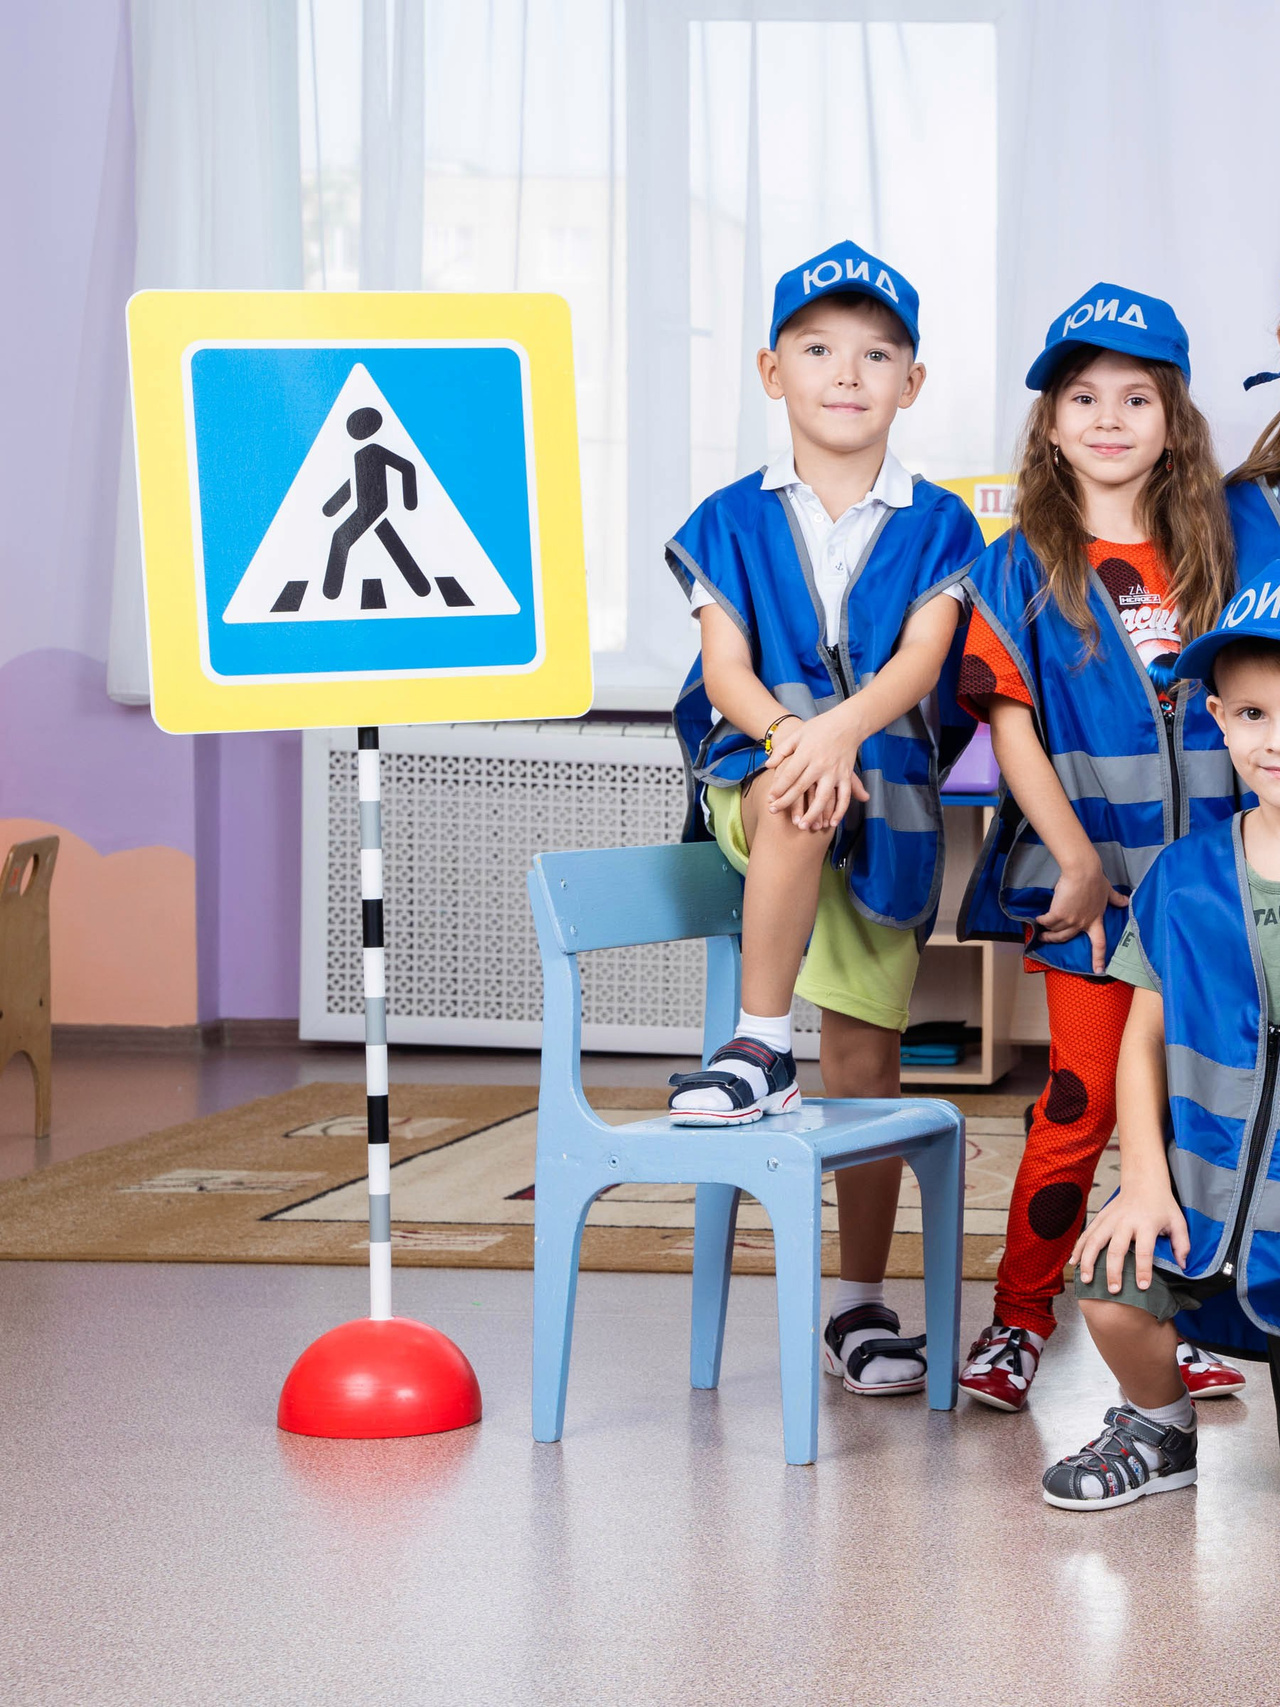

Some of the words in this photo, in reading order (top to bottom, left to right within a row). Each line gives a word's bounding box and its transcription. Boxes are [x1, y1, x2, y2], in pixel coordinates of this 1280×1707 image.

[802, 258, 899, 304] ЮИД
[1062, 298, 1148, 338] ЮИД
[1128, 584, 1150, 595] ZAG
